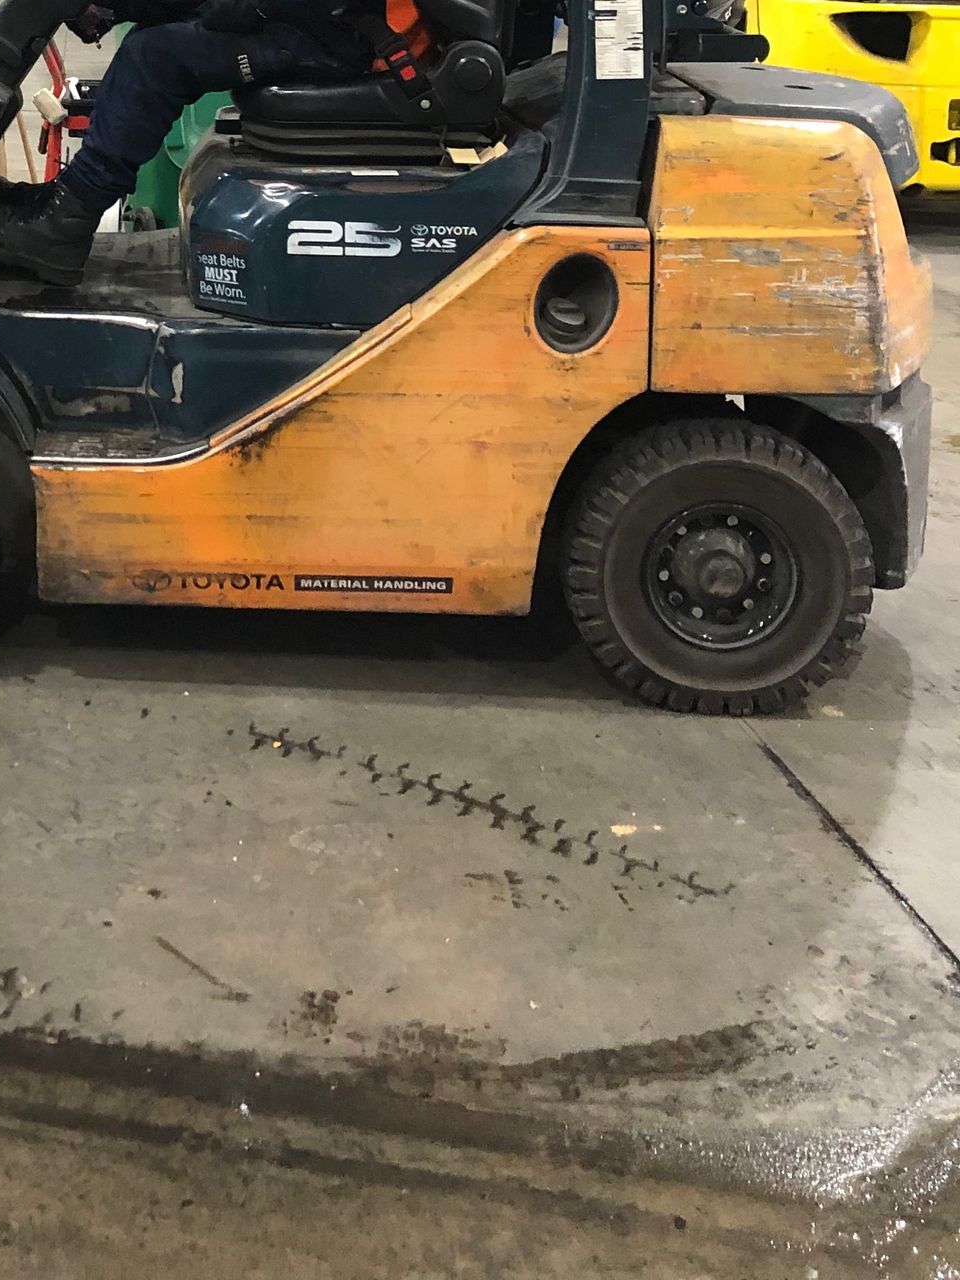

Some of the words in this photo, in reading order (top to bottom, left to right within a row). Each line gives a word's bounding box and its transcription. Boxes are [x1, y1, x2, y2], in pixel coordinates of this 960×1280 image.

[287, 220, 402, 257] 25
[430, 225, 478, 236] TOYOTA
[410, 238, 457, 248] SAS
[219, 253, 246, 269] Belts
[204, 266, 238, 282] MUST
[200, 280, 213, 295] Be
[214, 283, 246, 299] Worn.
[177, 572, 285, 591] TOYOTA
[299, 578, 369, 589] MATERIAL
[373, 579, 447, 591] HANDLING
